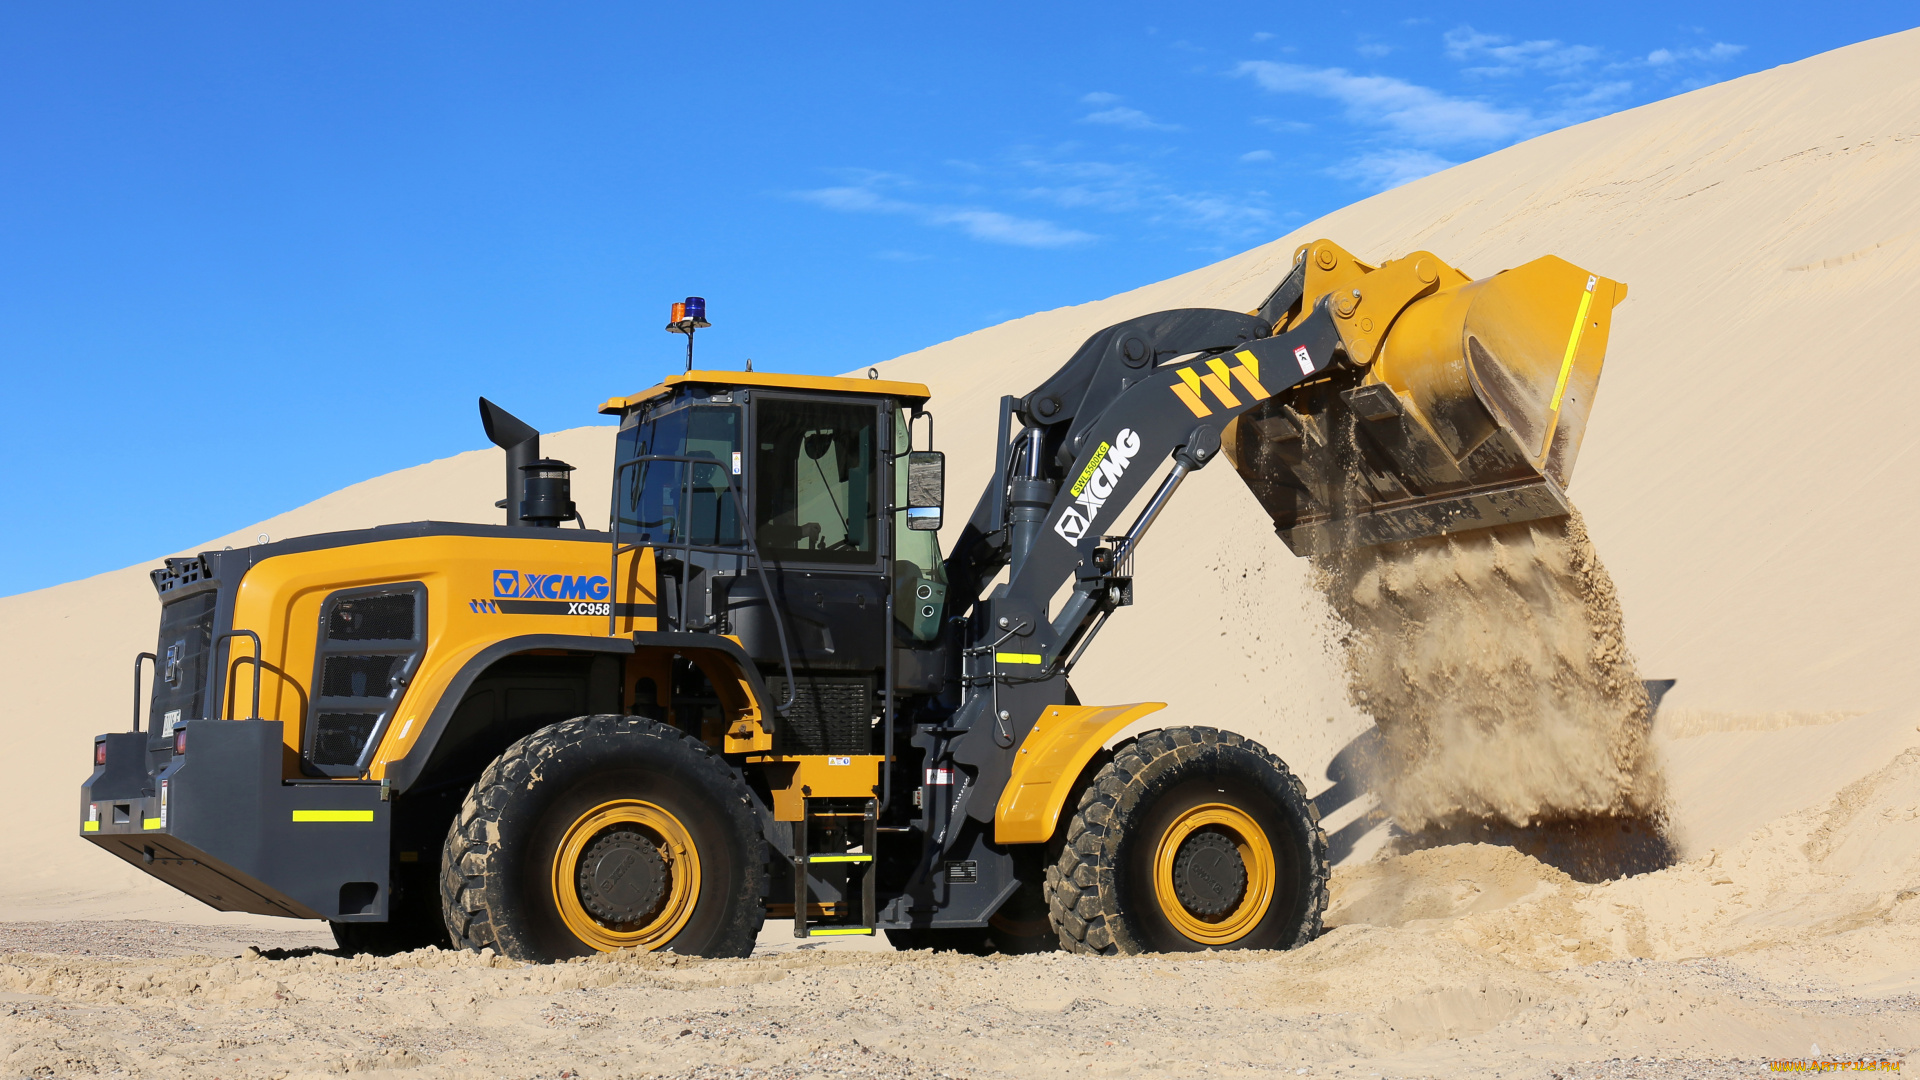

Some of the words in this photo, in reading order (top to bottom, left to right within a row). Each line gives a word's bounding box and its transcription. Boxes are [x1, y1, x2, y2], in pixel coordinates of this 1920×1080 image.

[1074, 475, 1089, 493] SWL
[1085, 445, 1108, 476] 5500KG
[1075, 428, 1141, 523] XCMG
[519, 574, 610, 600] XCMG
[567, 602, 610, 616] XC958
